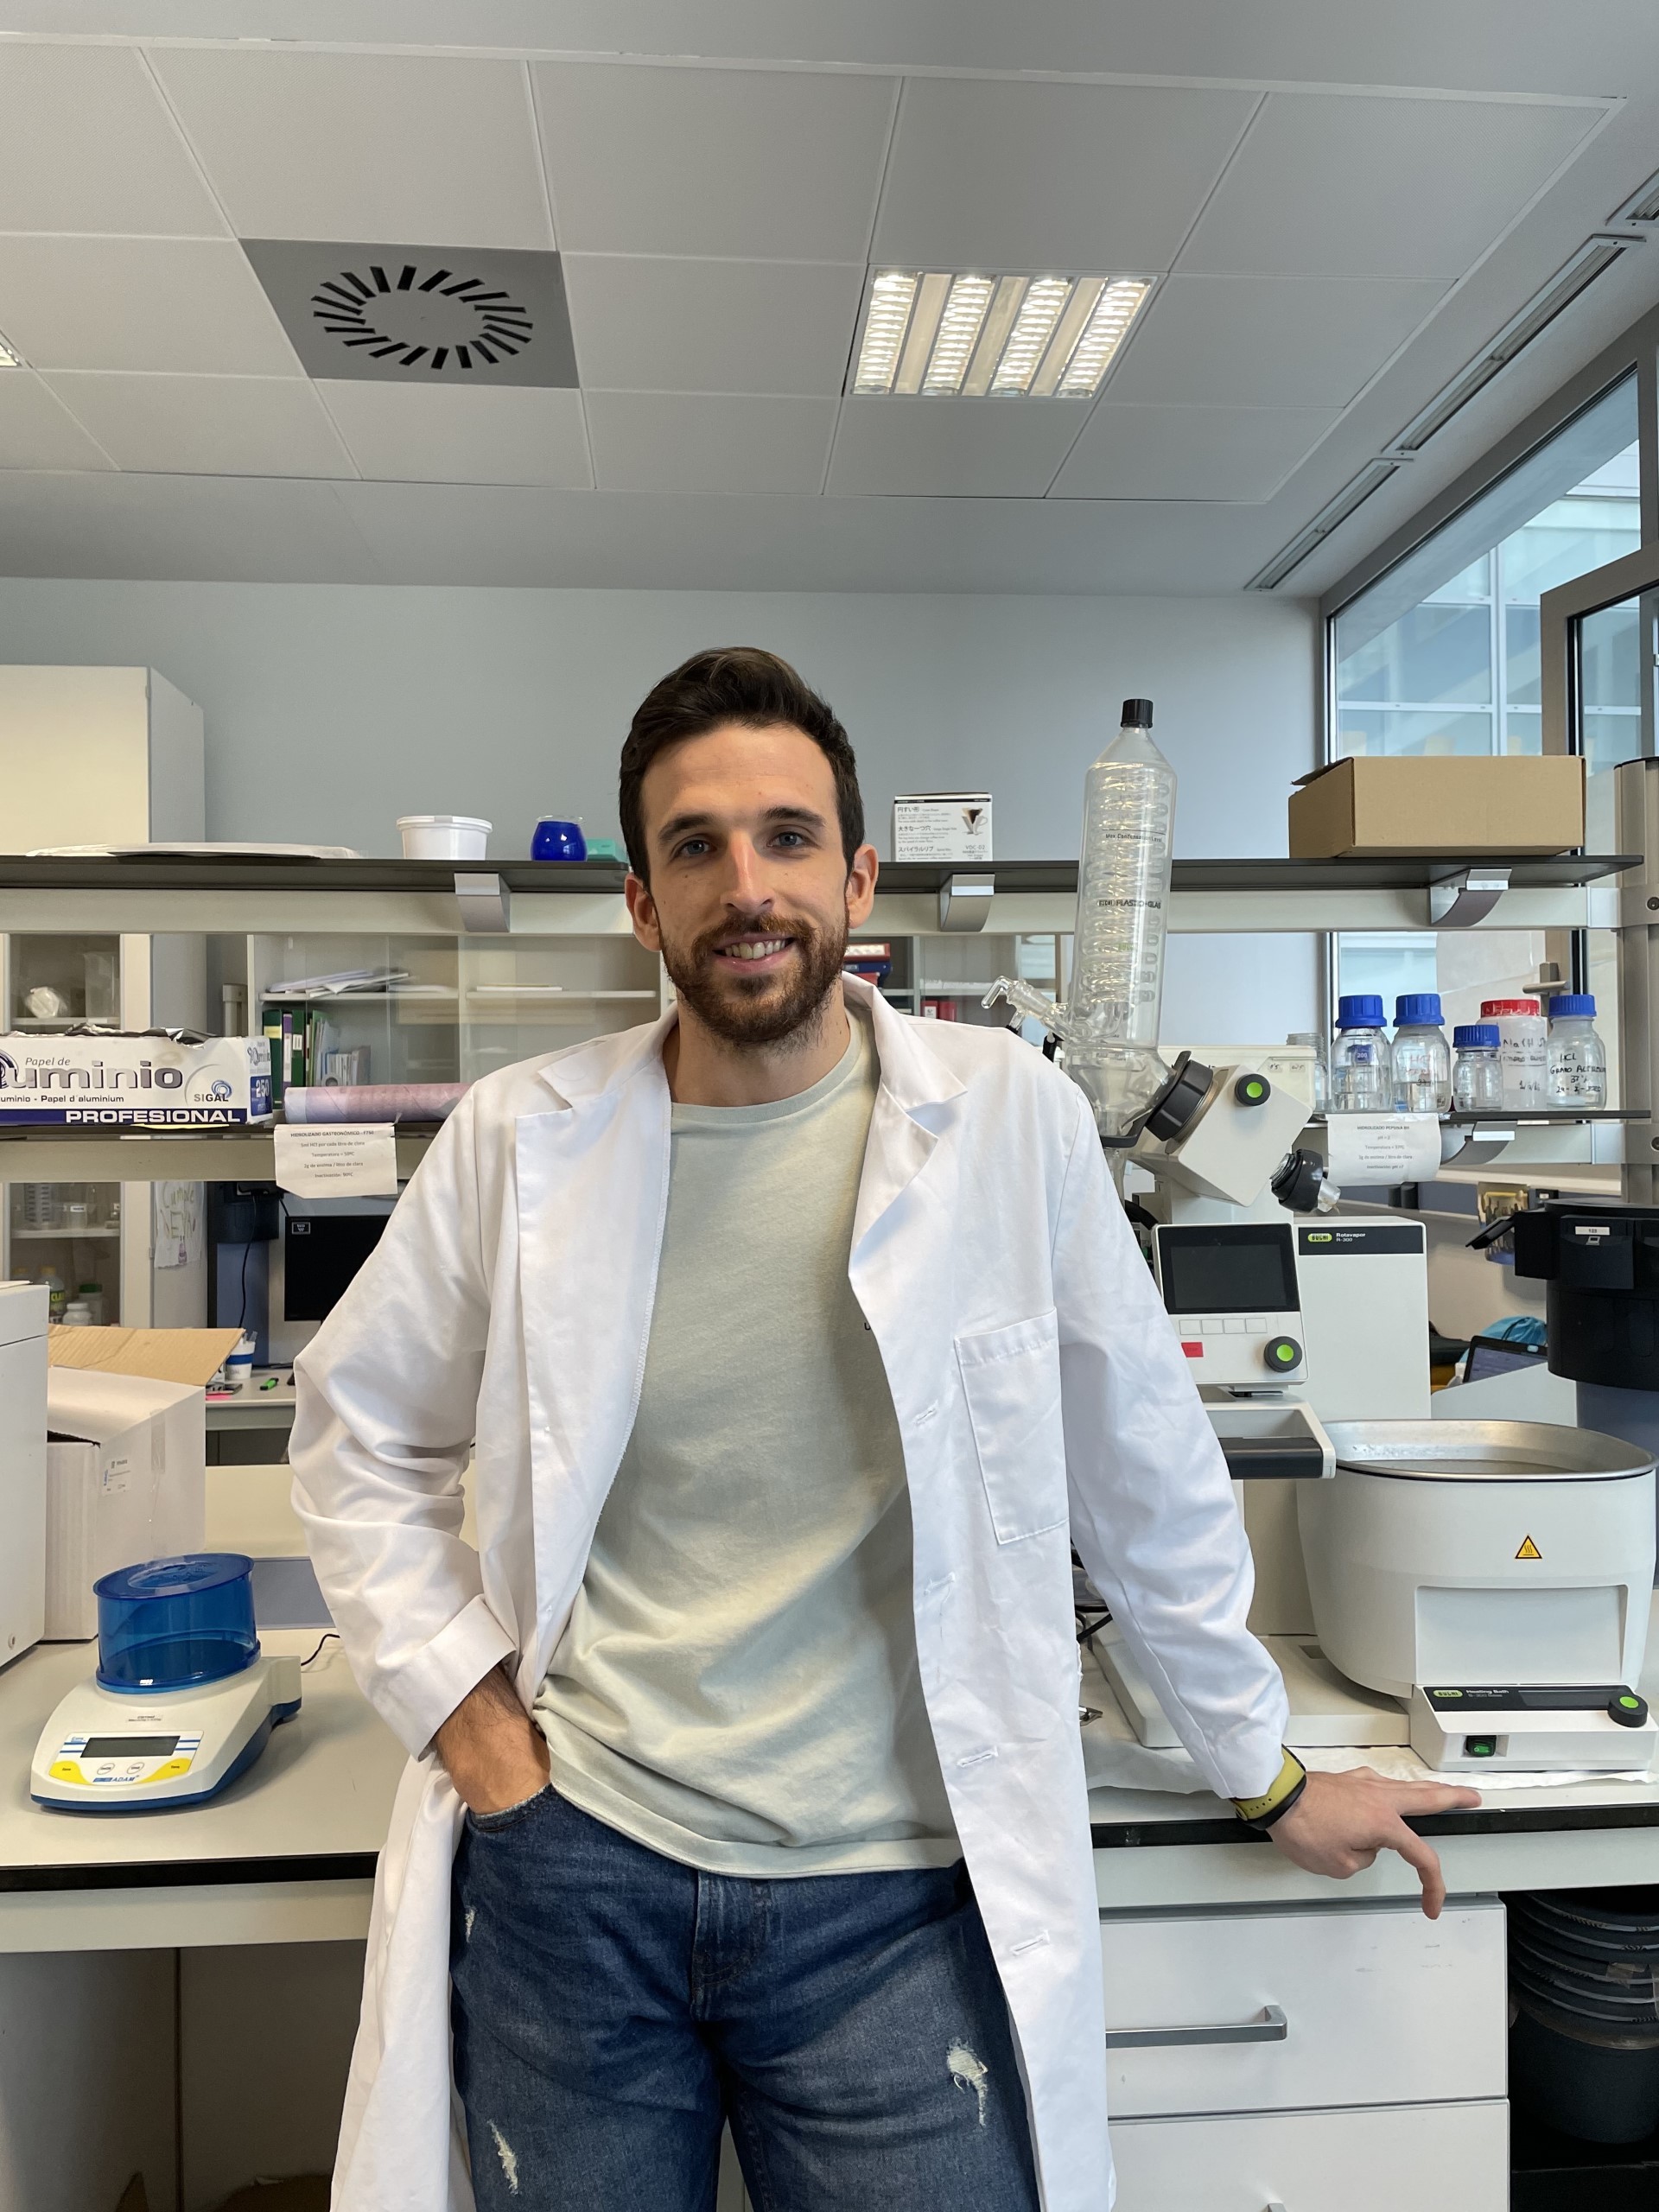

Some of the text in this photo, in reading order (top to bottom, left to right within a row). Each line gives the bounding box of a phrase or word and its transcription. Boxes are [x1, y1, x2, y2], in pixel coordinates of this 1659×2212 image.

[25, 1057, 71, 1067] Papel de
[256, 1078, 270, 1098] 250
[41, 1095, 67, 1103] Papel
[194, 1093, 229, 1102] SIGAL
[65, 1110, 241, 1123] PROFESIONAL
